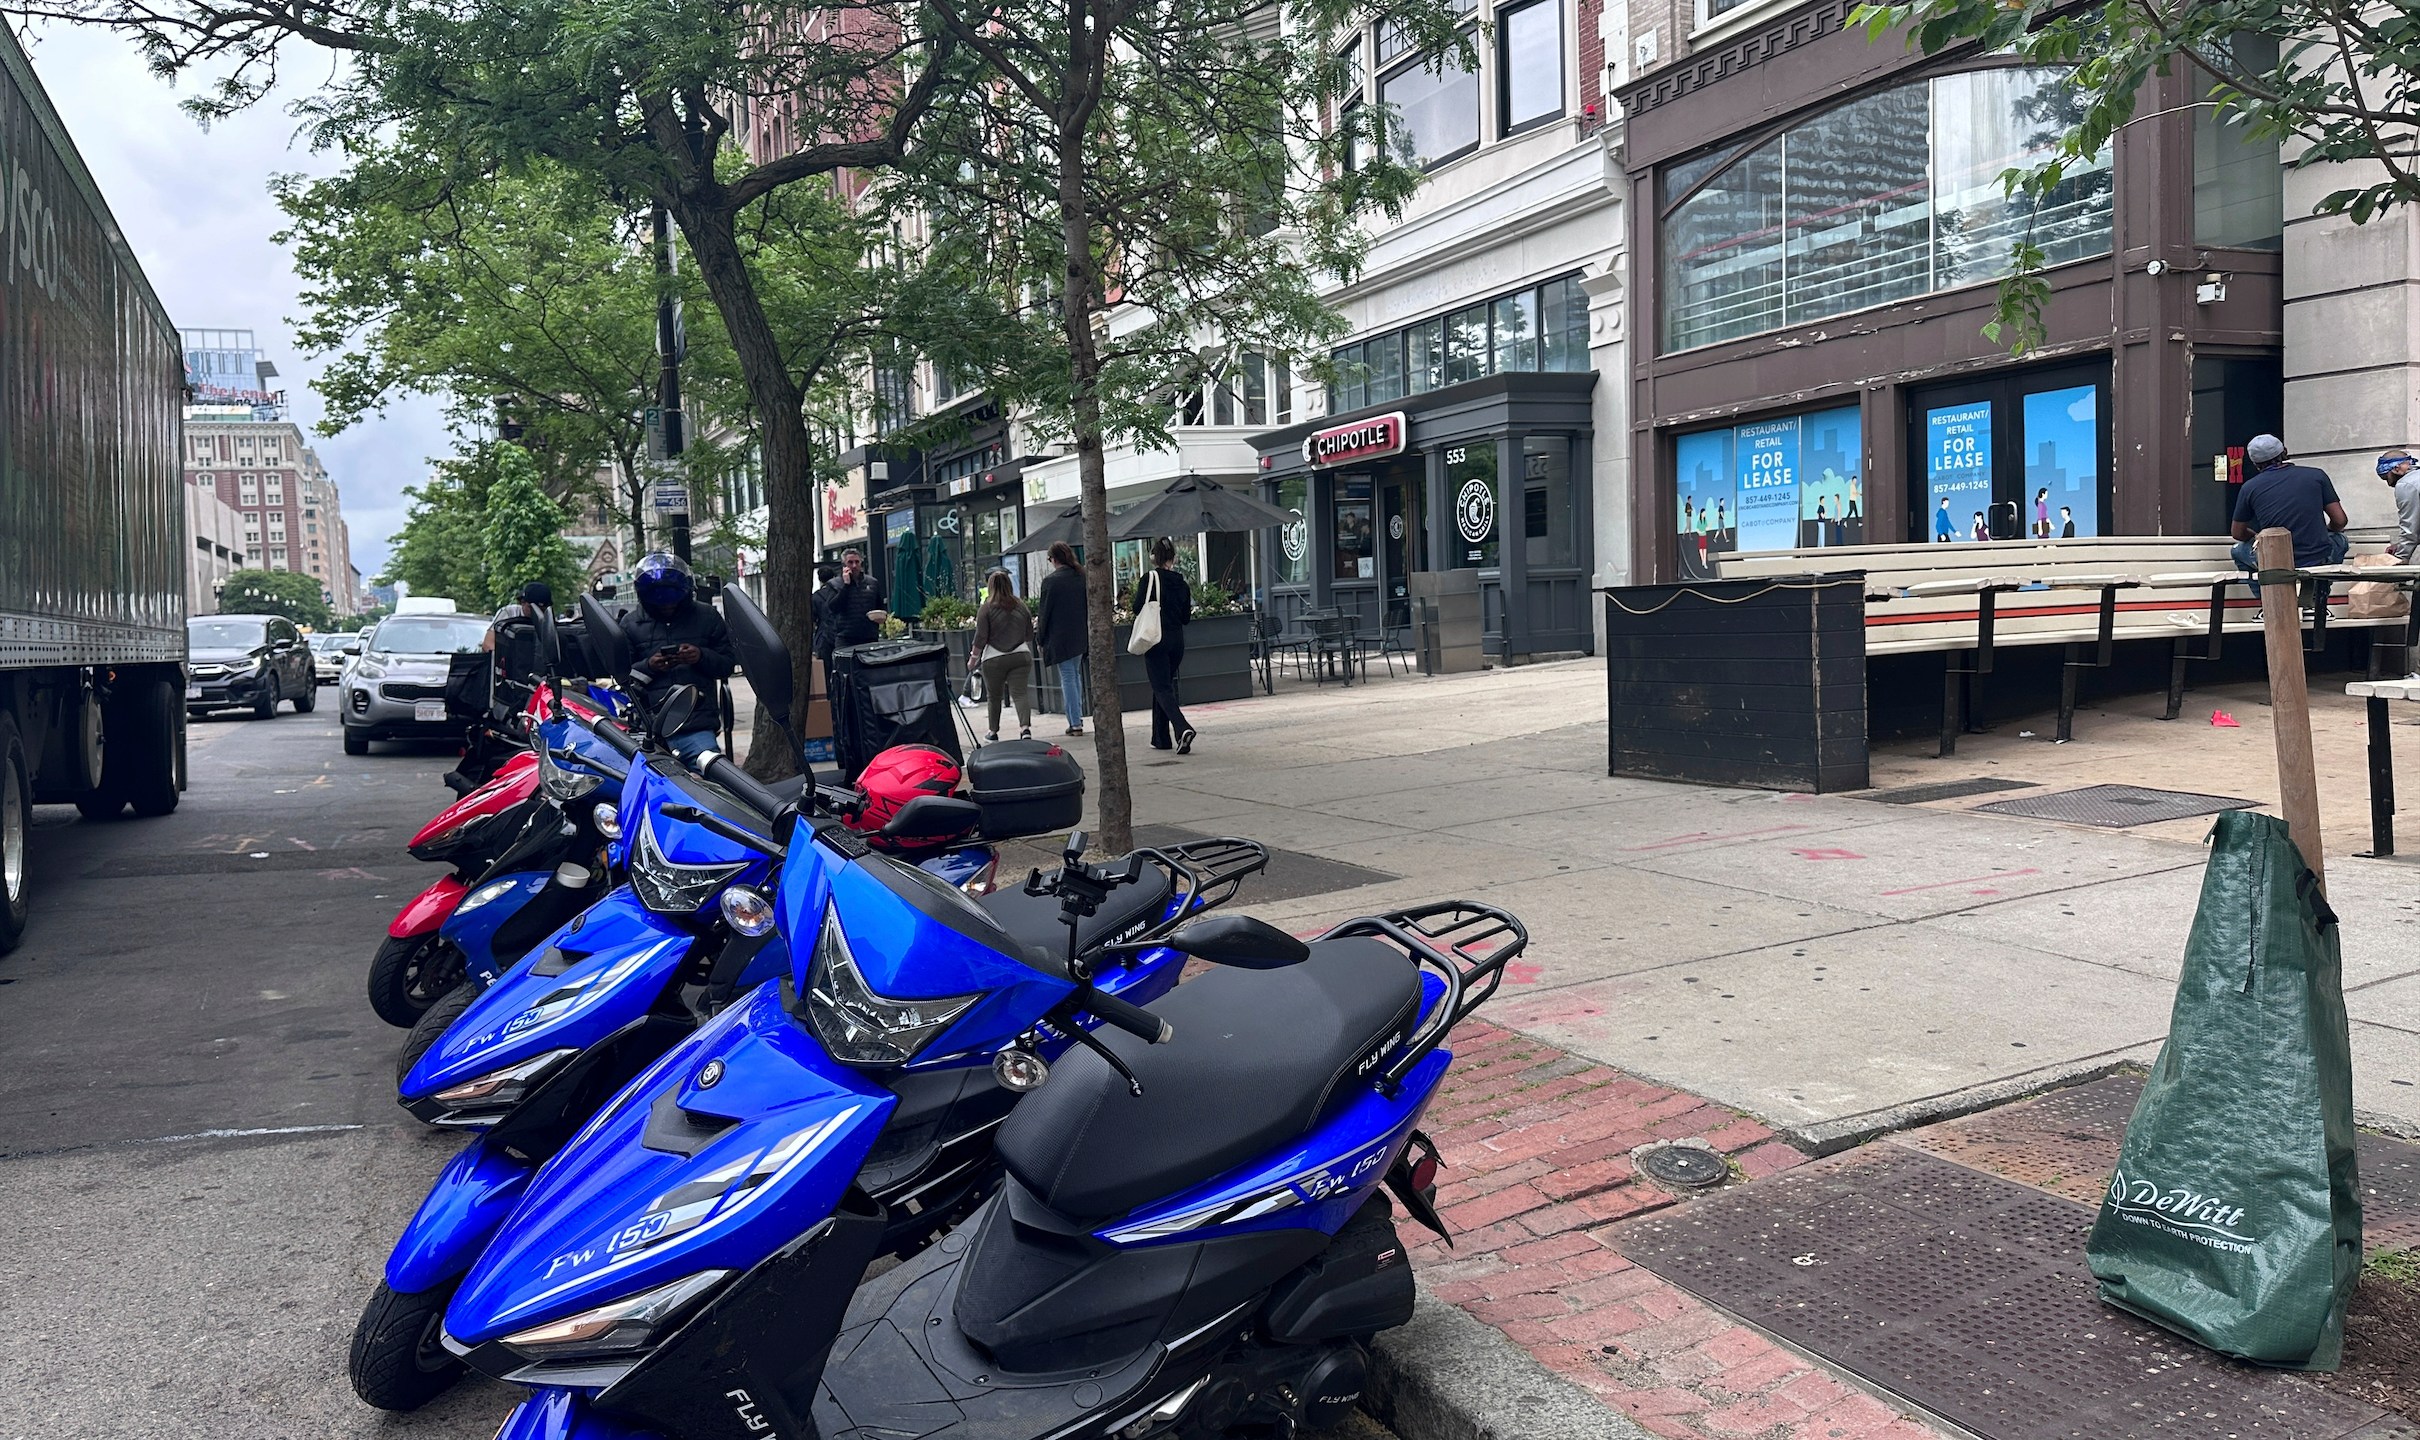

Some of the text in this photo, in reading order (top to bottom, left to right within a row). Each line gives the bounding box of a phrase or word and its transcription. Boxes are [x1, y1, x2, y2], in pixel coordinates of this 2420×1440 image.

[1931, 410, 1989, 426] RESTAURANT/
[1741, 421, 1797, 438] RESTAURANT/
[1946, 424, 1974, 436] RETAIL
[1318, 424, 1385, 456] CHIPOTLE
[1755, 437, 1783, 449] RETAIL
[1944, 437, 1975, 454] FOR
[1447, 448, 1465, 465] 553
[1752, 451, 1783, 470] FOR
[1935, 452, 1984, 471] LEASE
[1744, 468, 1792, 489] LEASE
[1933, 480, 1989, 494] 857-449-1245
[669, 498, 686, 506] 456
[1460, 484, 1489, 508] CHIPOTLE
[1745, 492, 1791, 505] 857-449-1245
[1125, 920, 1146, 939] WING
[501, 1008, 543, 1035] 150
[1358, 1031, 1401, 1076] FLY WING
[1351, 1146, 1388, 1178] 150
[2131, 1179, 2245, 1228] DeWitt
[605, 1211, 669, 1254] 150
[2122, 1213, 2252, 1255] DOWN TO EARTH PROTECTION
[1319, 1391, 1360, 1404] FLY WING
[726, 1389, 769, 1430] FLY
